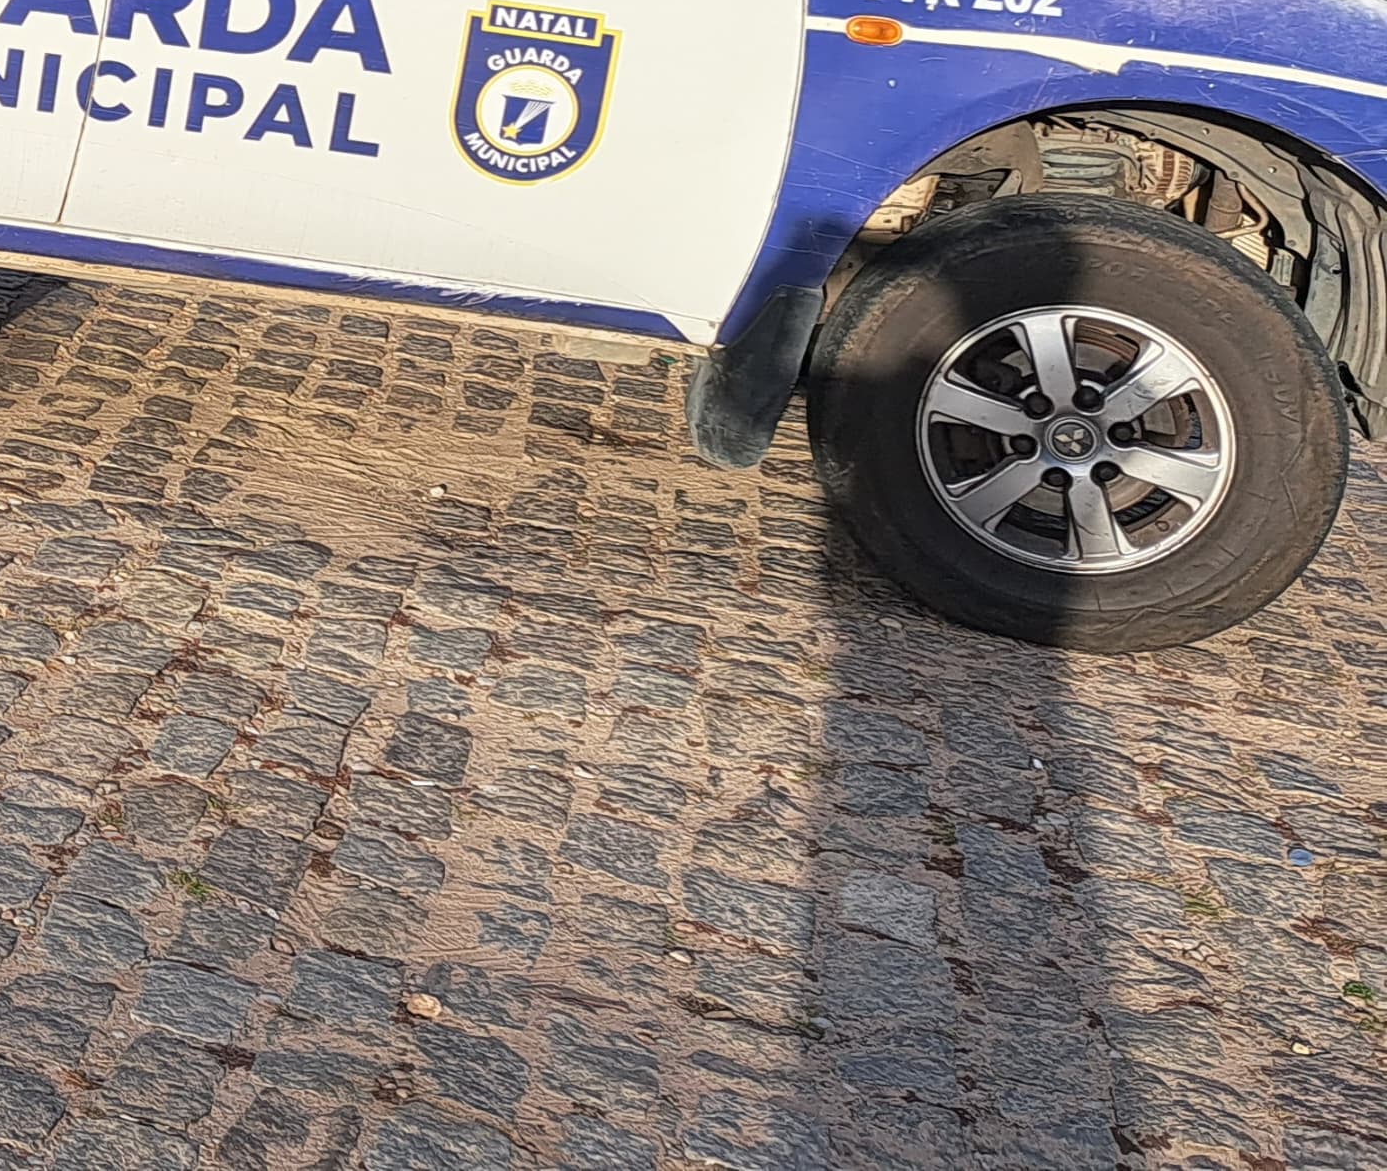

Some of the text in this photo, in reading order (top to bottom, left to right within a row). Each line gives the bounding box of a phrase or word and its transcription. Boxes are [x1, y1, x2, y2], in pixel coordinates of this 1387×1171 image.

[494, 7, 589, 38] NATAL
[486, 47, 584, 86] GUARDA
[463, 132, 577, 173] MUNICIPAL
